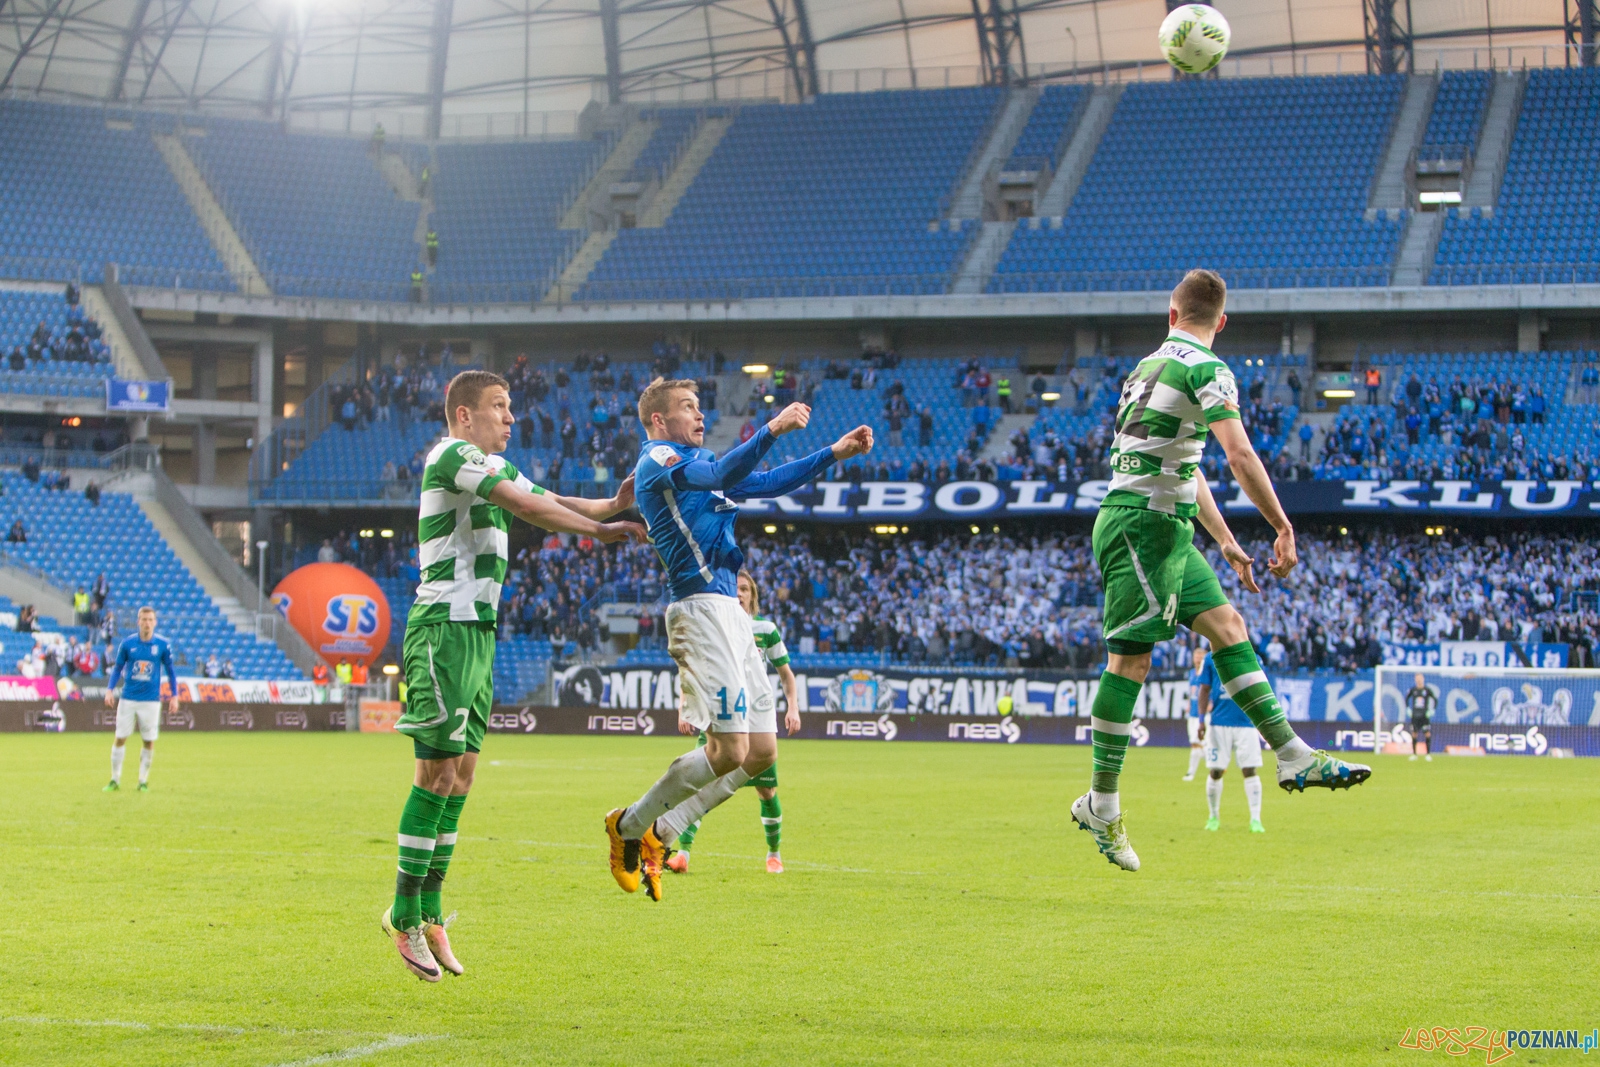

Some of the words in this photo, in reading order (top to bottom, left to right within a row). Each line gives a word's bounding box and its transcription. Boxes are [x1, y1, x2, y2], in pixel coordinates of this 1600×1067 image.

[1343, 480, 1600, 511] KLU
[324, 595, 378, 637] STS
[716, 686, 748, 721] 14
[449, 707, 469, 742] 2
[588, 714, 637, 731] inea
[826, 719, 876, 737] inea
[948, 722, 1001, 739] inea
[1469, 732, 1527, 751] inea
